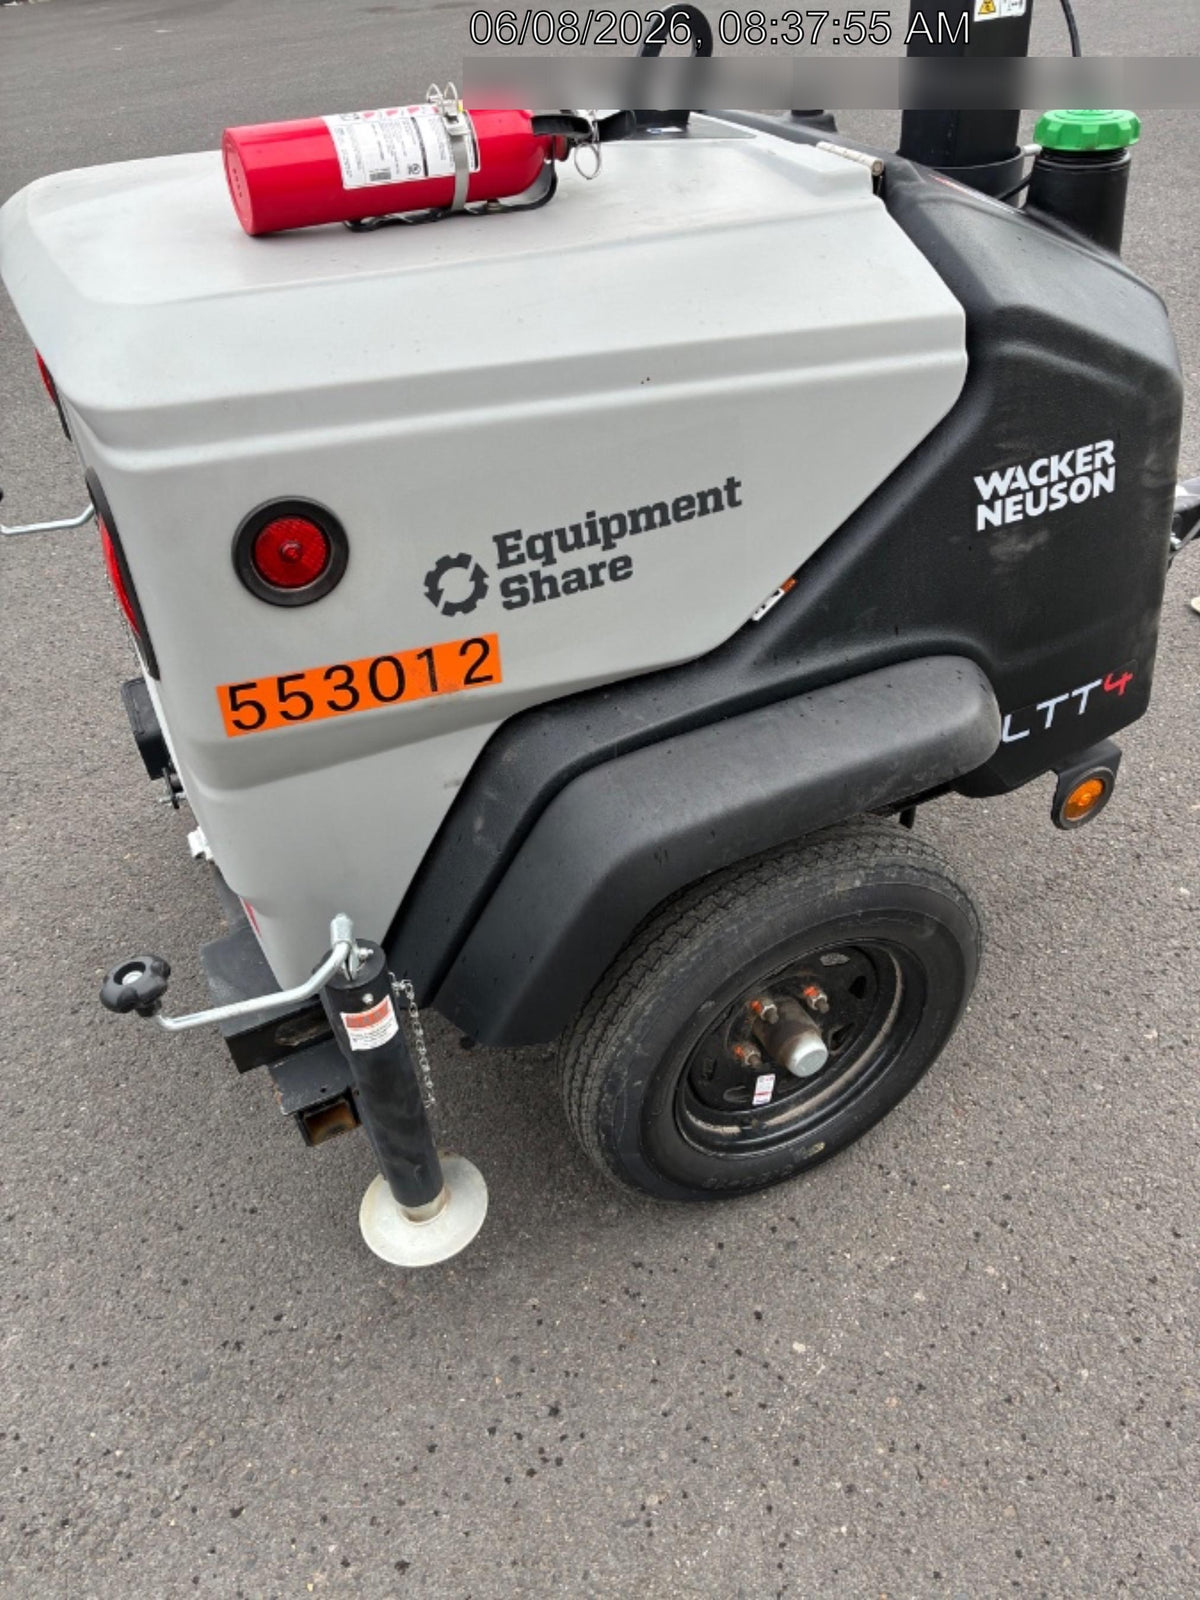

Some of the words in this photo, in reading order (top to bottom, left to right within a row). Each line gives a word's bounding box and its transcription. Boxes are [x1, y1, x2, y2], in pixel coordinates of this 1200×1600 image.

[974, 439, 1116, 501] WACKER
[977, 466, 1116, 532] NEUSON
[492, 476, 742, 567] Equipment
[500, 554, 633, 610] Share
[228, 637, 493, 730] 553012
